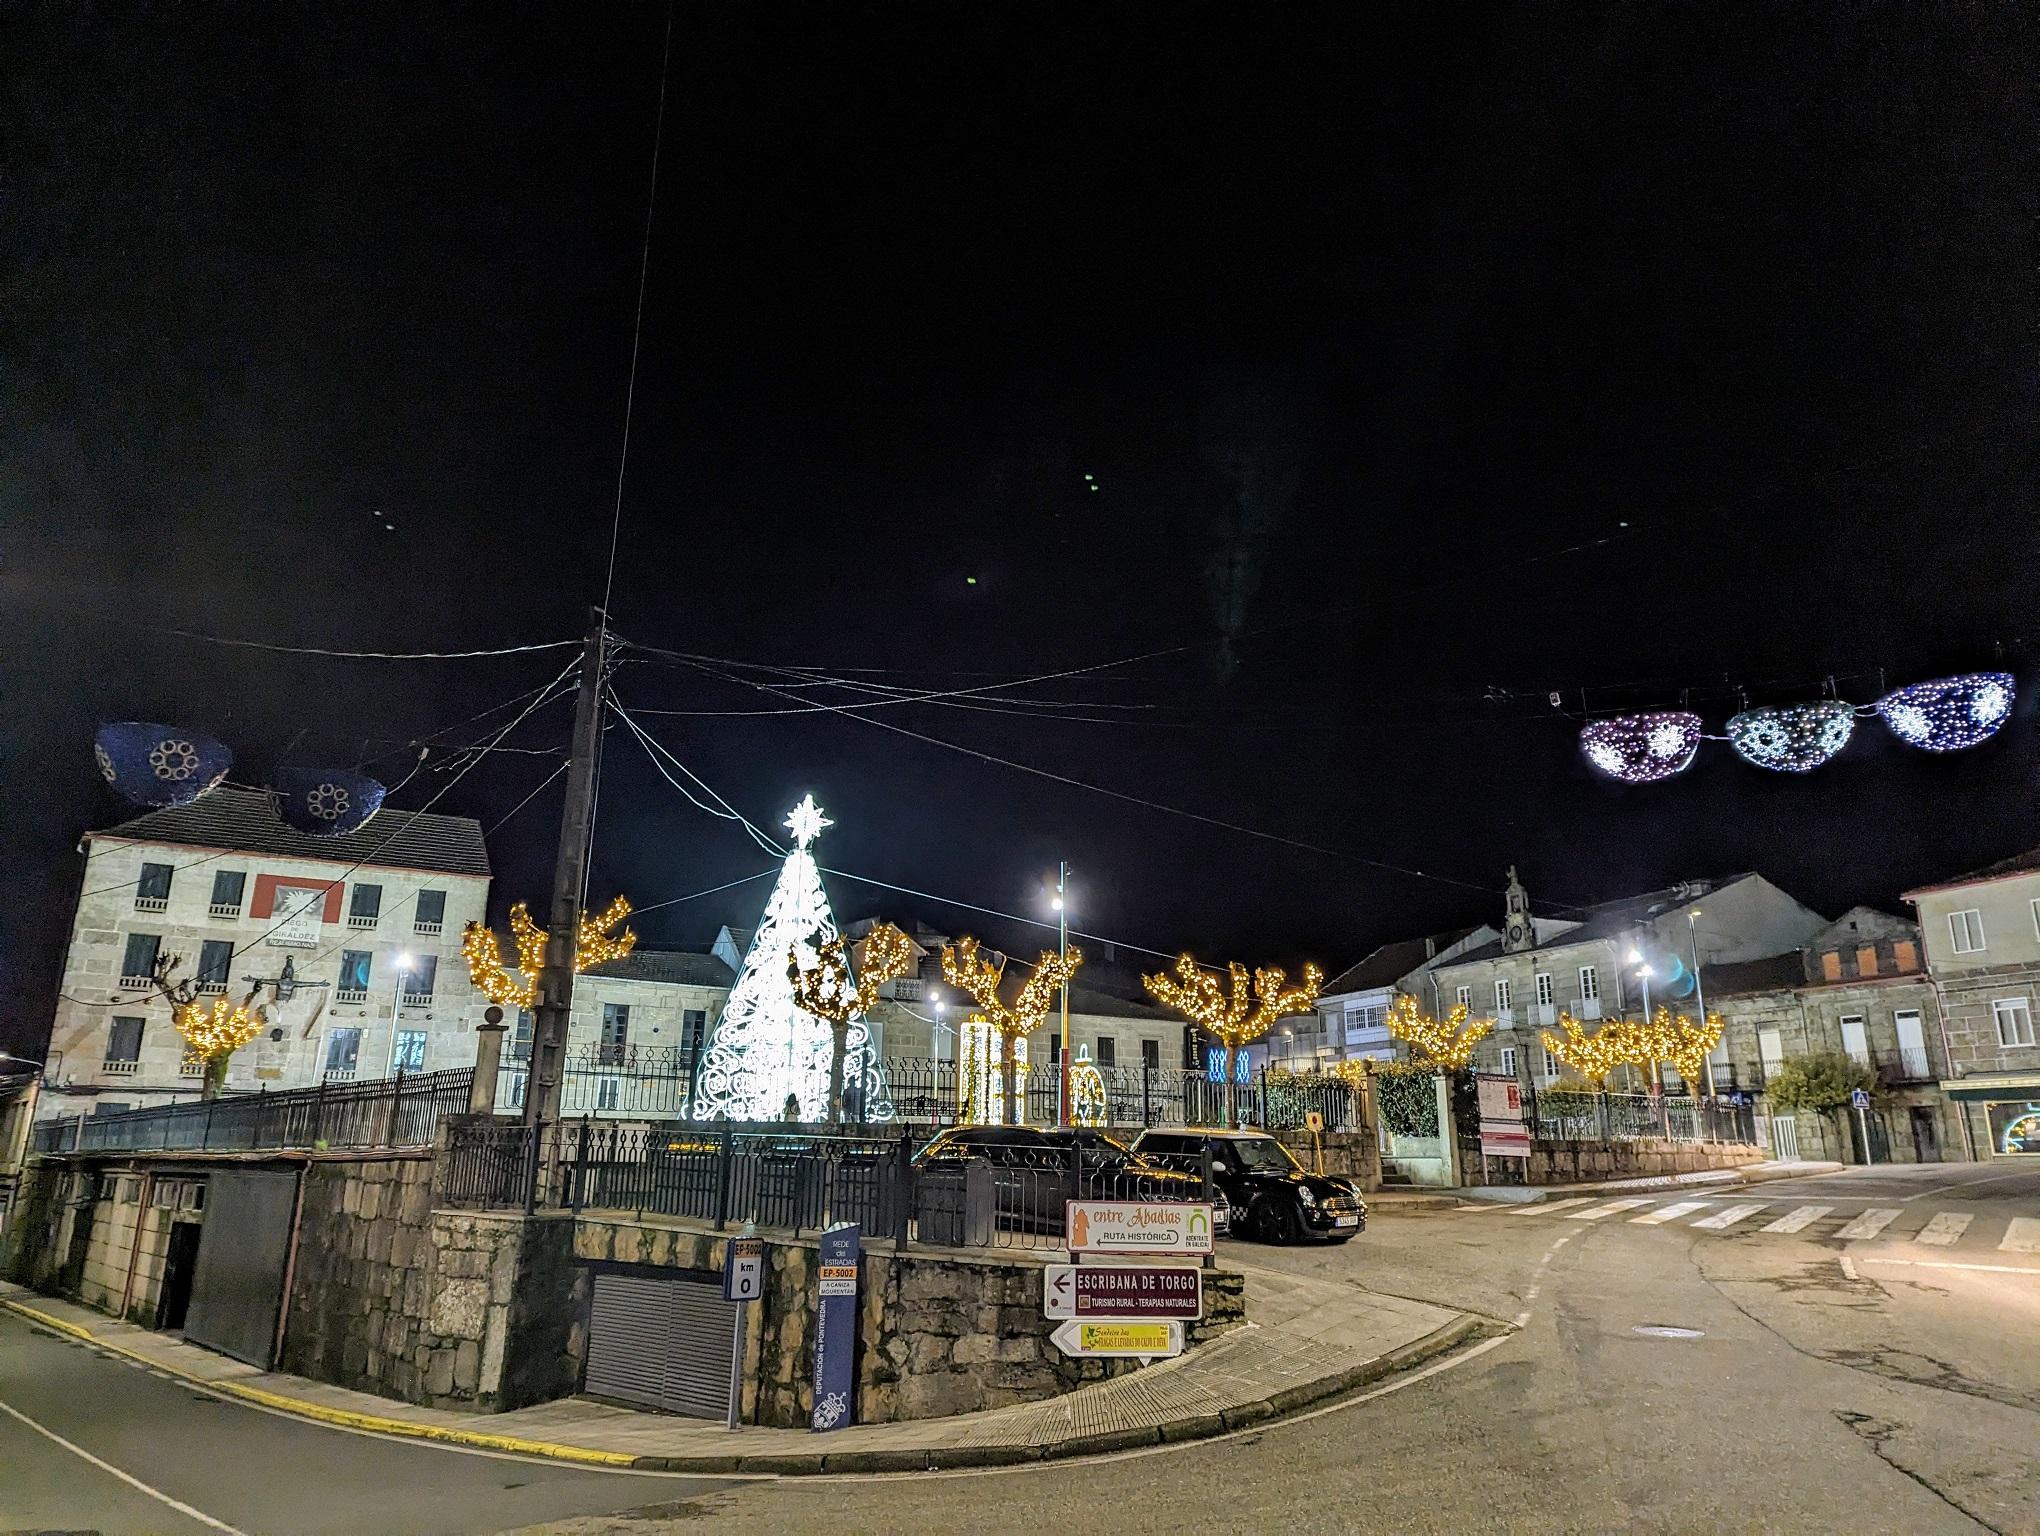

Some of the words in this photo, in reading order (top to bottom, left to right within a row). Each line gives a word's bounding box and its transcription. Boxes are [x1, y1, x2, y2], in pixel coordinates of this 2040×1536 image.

[1094, 1209, 1124, 1224] entre
[1103, 1232, 1126, 1241] RUTA
[1127, 1231, 1172, 1241] HISTÓRICA
[735, 1243, 761, 1255] EP-5002
[832, 1240, 849, 1248] REDE
[741, 1263, 754, 1272] km
[823, 1269, 854, 1278] EP-5002
[1078, 1274, 1138, 1290] ESCRIBANA
[1142, 1275, 1156, 1290] DE
[1159, 1276, 1195, 1290] TORGO
[1092, 1298, 1116, 1307] TURISMO
[1116, 1298, 1135, 1307] RURAL
[1138, 1299, 1165, 1308] TERAPIAS
[1165, 1299, 1197, 1308] NATURALES
